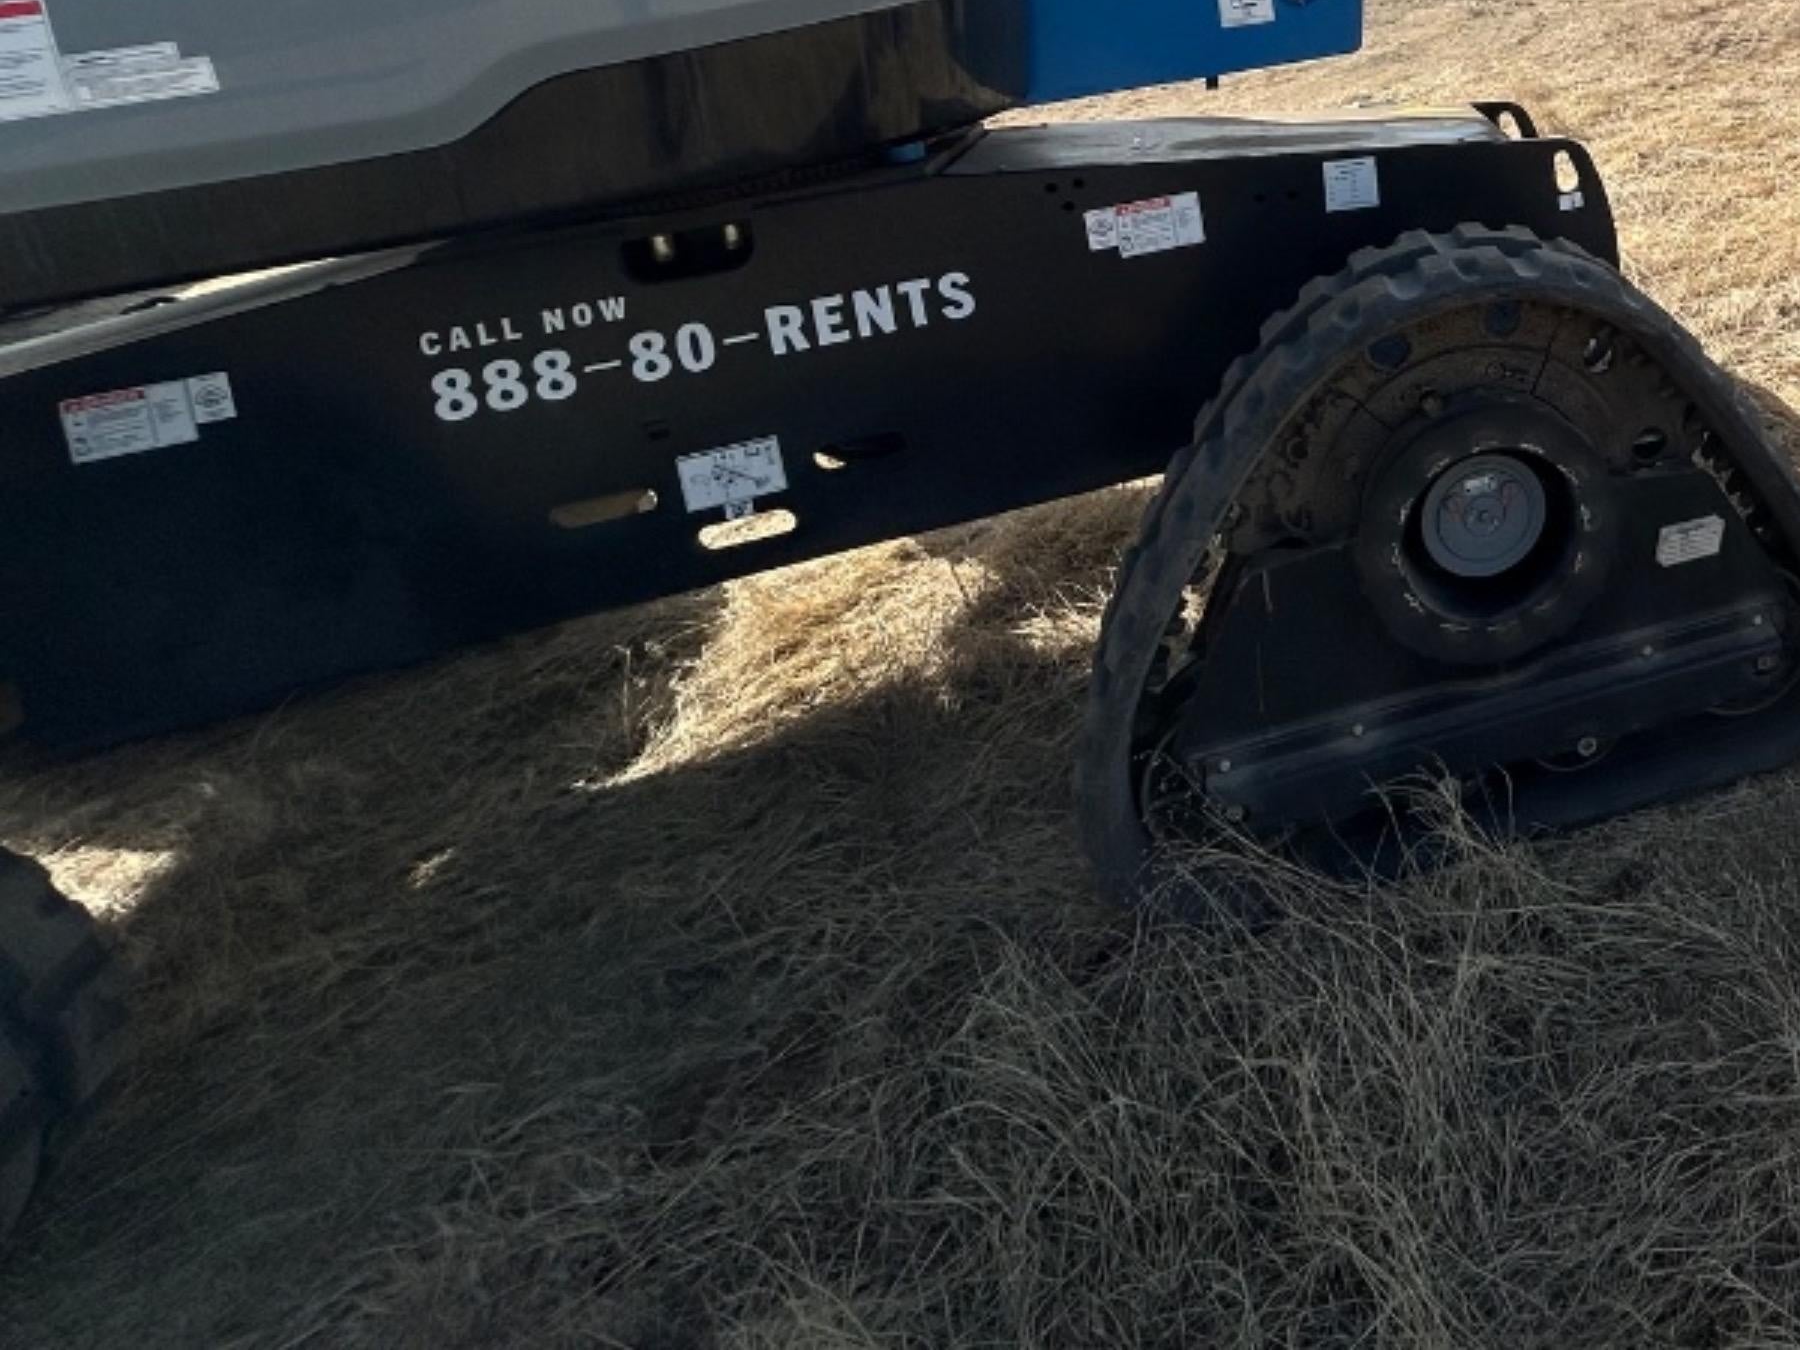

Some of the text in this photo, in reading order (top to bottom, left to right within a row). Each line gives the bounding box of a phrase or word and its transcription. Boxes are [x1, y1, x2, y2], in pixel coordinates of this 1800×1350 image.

[419, 296, 628, 356] CALL NOW
[430, 271, 977, 422] 888-80-RENTS
